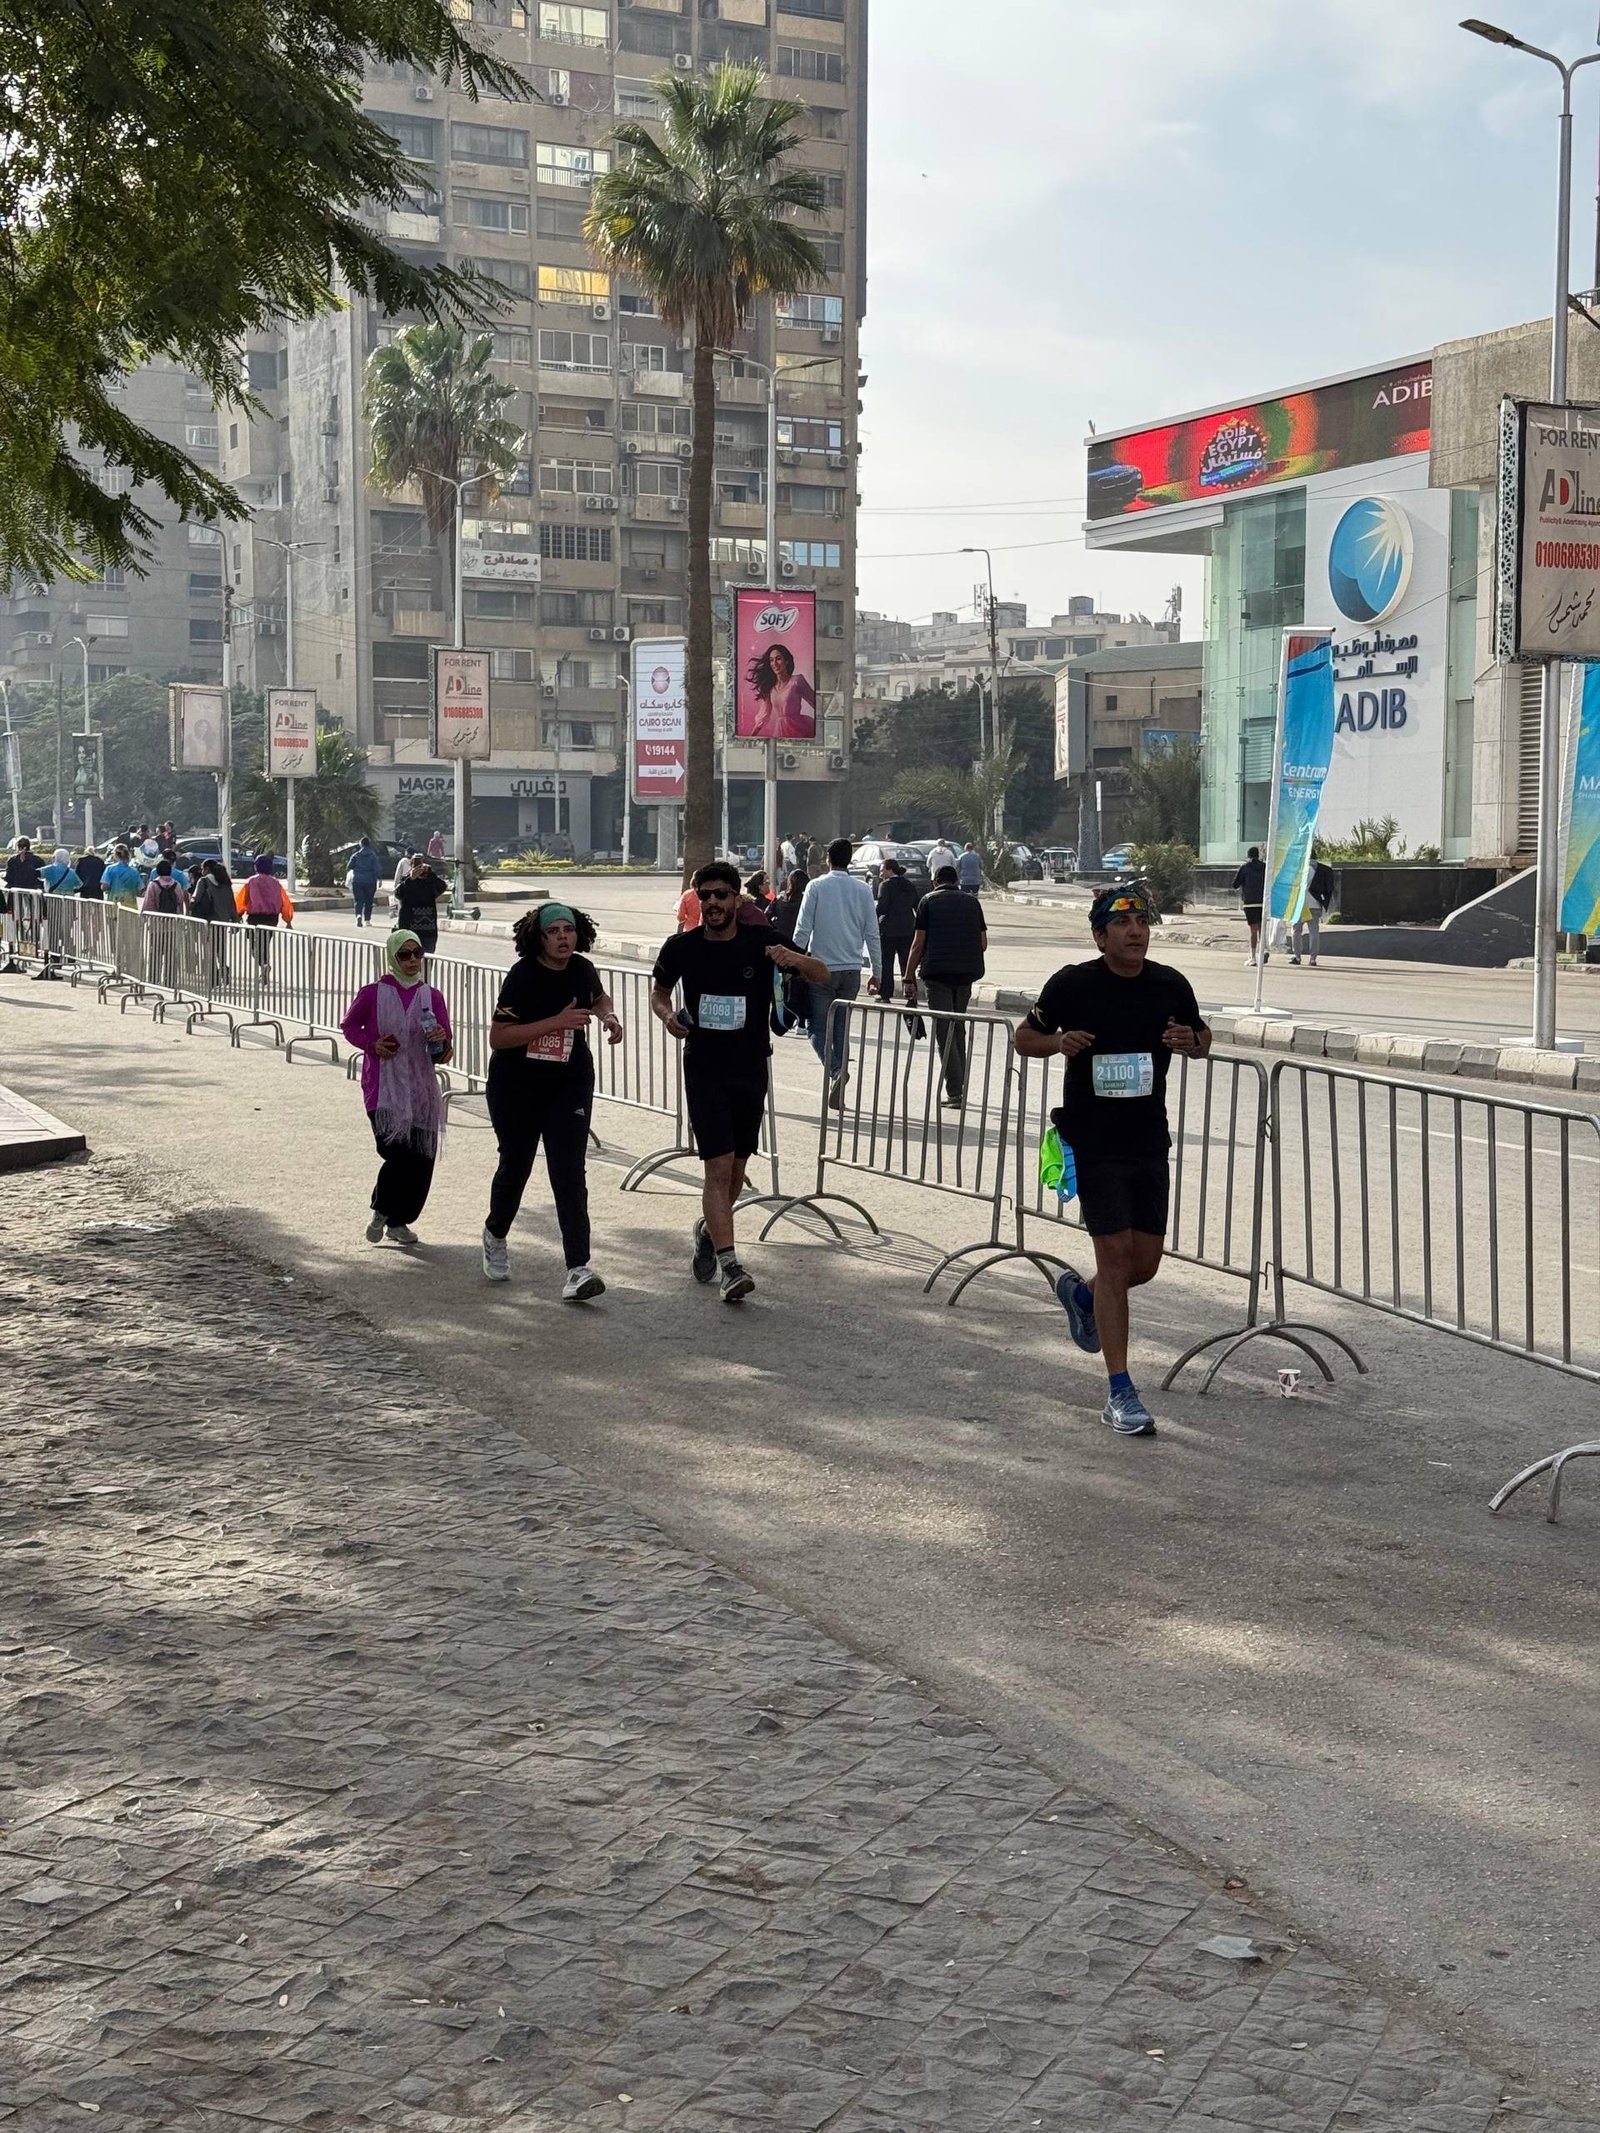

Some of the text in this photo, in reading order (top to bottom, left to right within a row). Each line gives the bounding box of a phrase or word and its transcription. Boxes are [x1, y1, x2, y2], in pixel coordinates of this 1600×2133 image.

[1372, 379, 1433, 410] ADIB
[1216, 426, 1247, 443] ADIB
[1540, 428, 1600, 450] FOR REN
[1208, 434, 1257, 457] EGYPT
[760, 612, 790, 628] SOFY
[1380, 634, 1418, 655] مصرف
[444, 658, 482, 668] FOR RENT
[274, 699, 289, 707] FOR
[1335, 688, 1407, 733] ADIB
[638, 718, 682, 727] CAIRO SCAN
[652, 745, 675, 756] 19144
[701, 1002, 730, 1017] 21098
[1097, 1065, 1135, 1080] 21100
